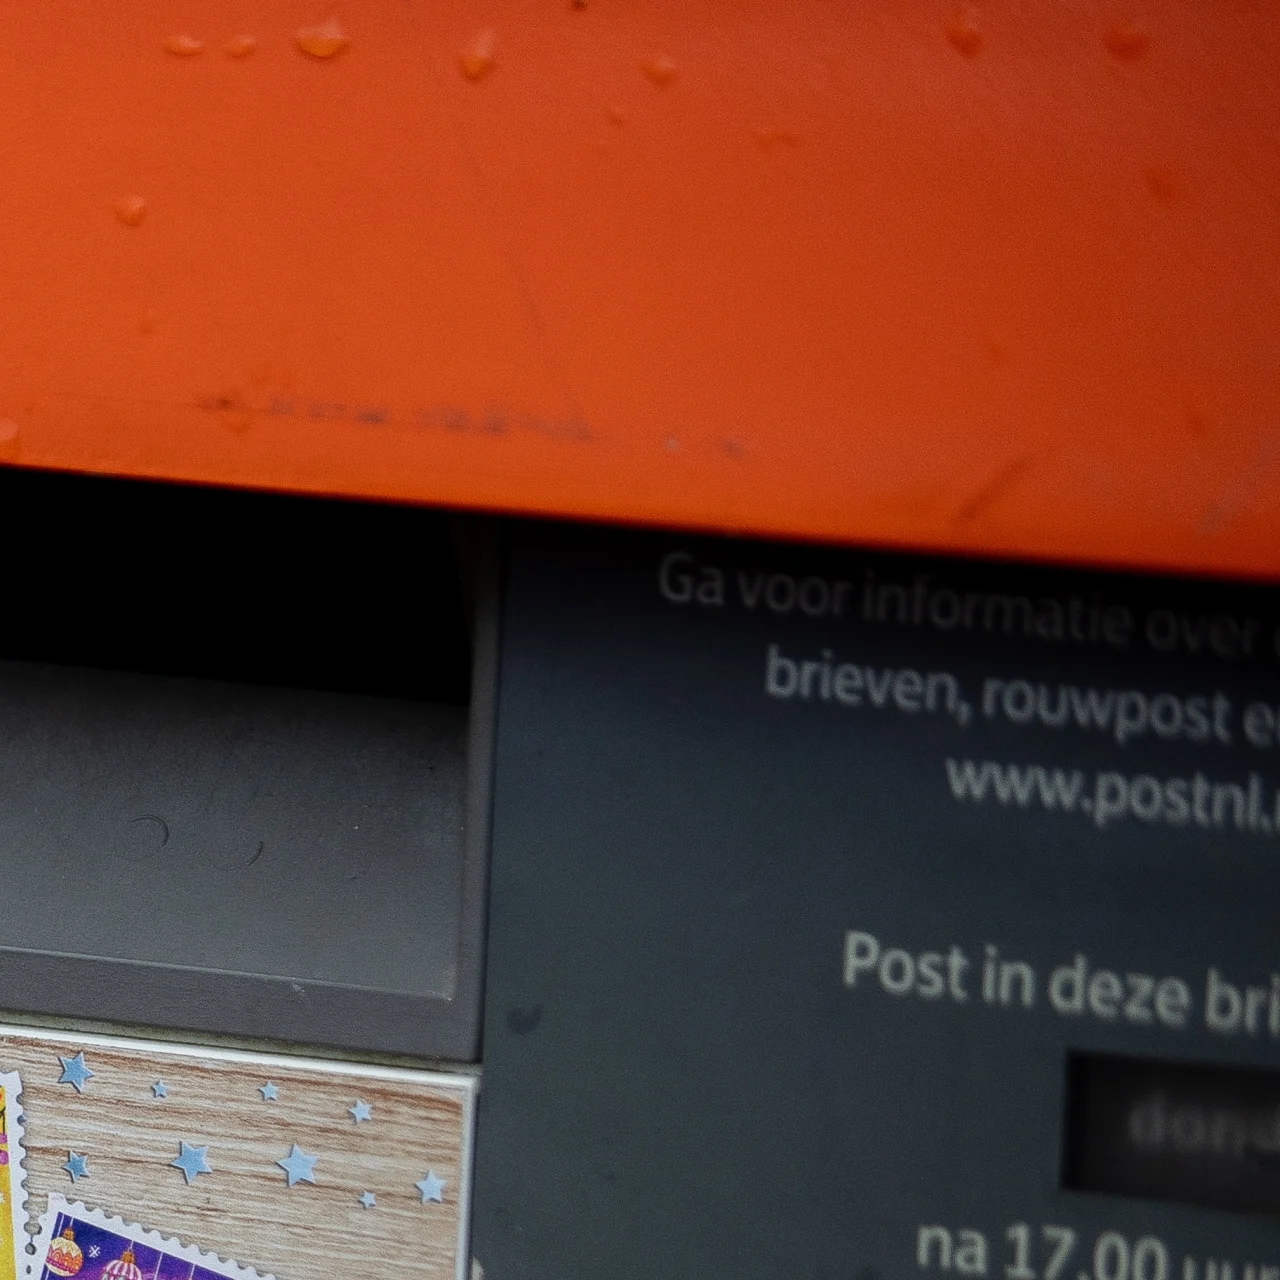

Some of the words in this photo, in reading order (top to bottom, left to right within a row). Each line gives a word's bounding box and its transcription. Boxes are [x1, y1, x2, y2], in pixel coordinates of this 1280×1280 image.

[657, 549, 725, 607] Ga
[737, 570, 853, 618] voor
[861, 568, 1133, 648] informatie
[1144, 608, 1260, 658] over
[764, 643, 971, 727] brieven,
[982, 675, 1232, 746] rouwpost
[1242, 700, 1280, 751] e
[945, 755, 1280, 834] www.postnl.
[844, 929, 969, 1001] Post
[981, 943, 1035, 1009] in
[1048, 951, 1192, 1027] deze
[917, 1223, 988, 1277] na
